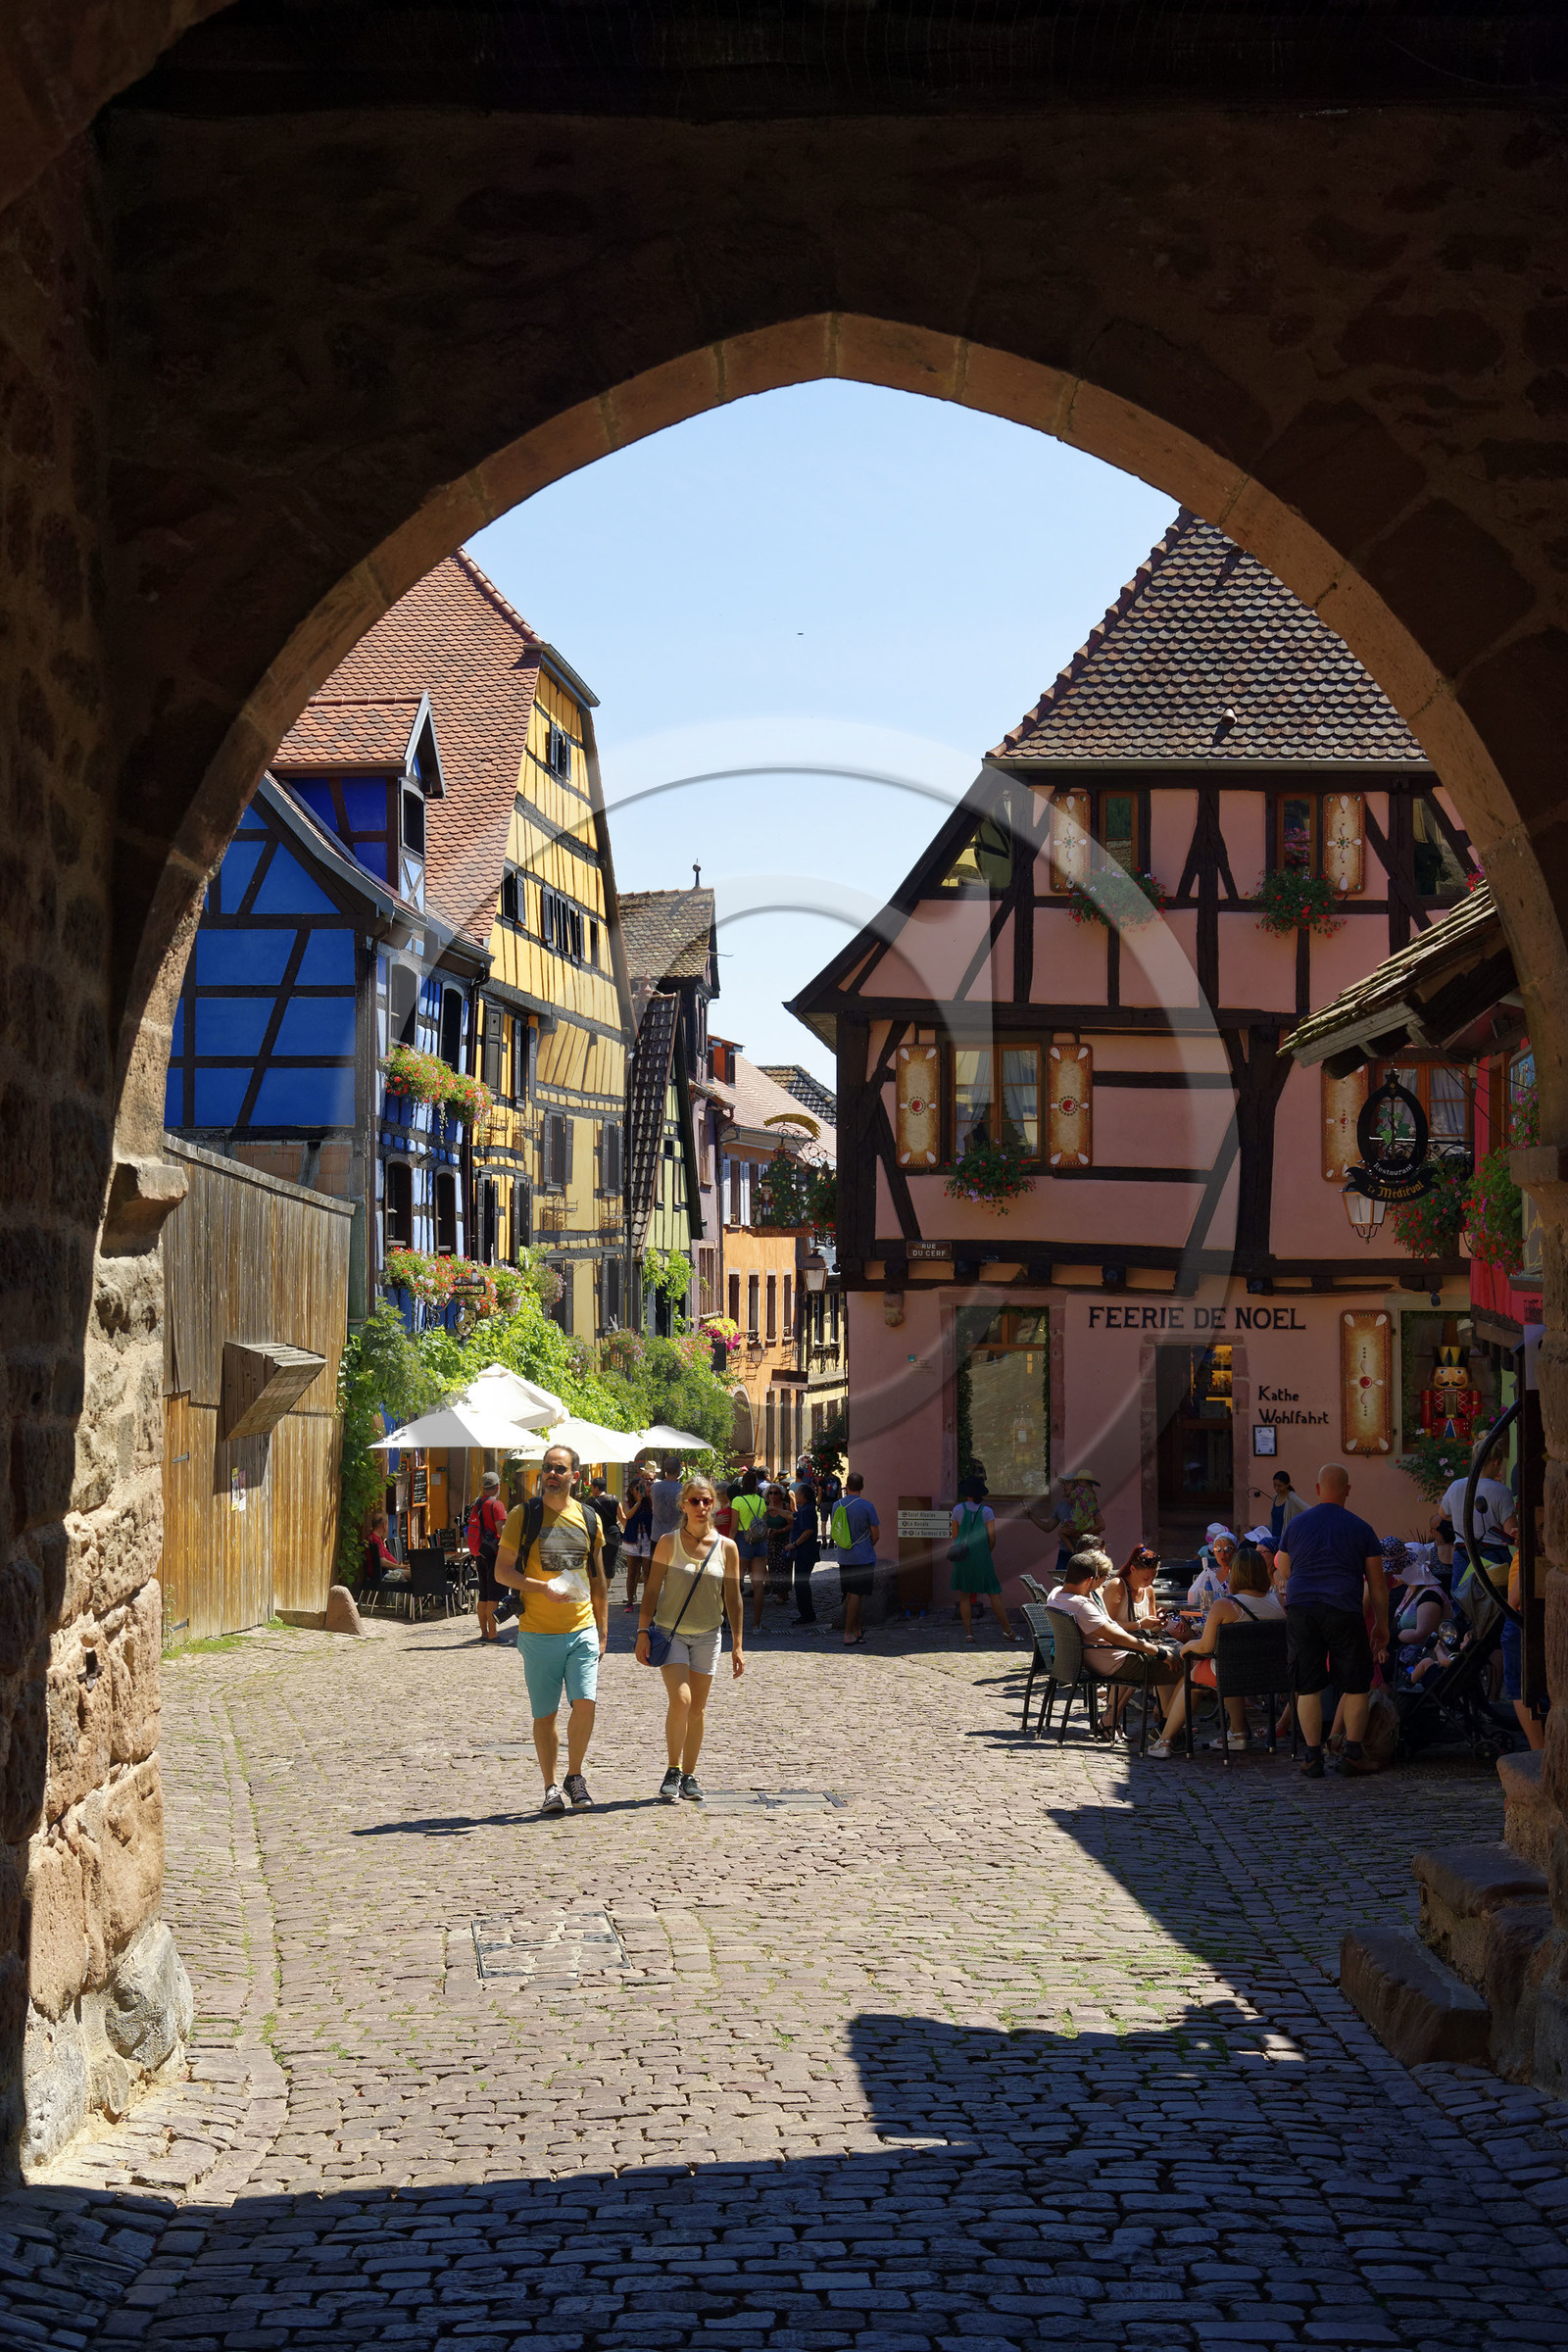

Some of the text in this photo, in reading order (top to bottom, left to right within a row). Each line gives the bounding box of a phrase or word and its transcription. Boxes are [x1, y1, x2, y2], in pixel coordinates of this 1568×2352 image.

[1373, 1162, 1414, 1176] Restaurant
[1366, 1180, 1425, 1199] Le Médiéval
[1088, 1305, 1306, 1330] FEERIE DE NOEL
[1258, 1385, 1299, 1401] Kathe
[1258, 1408, 1329, 1424] Wohlfahrt
